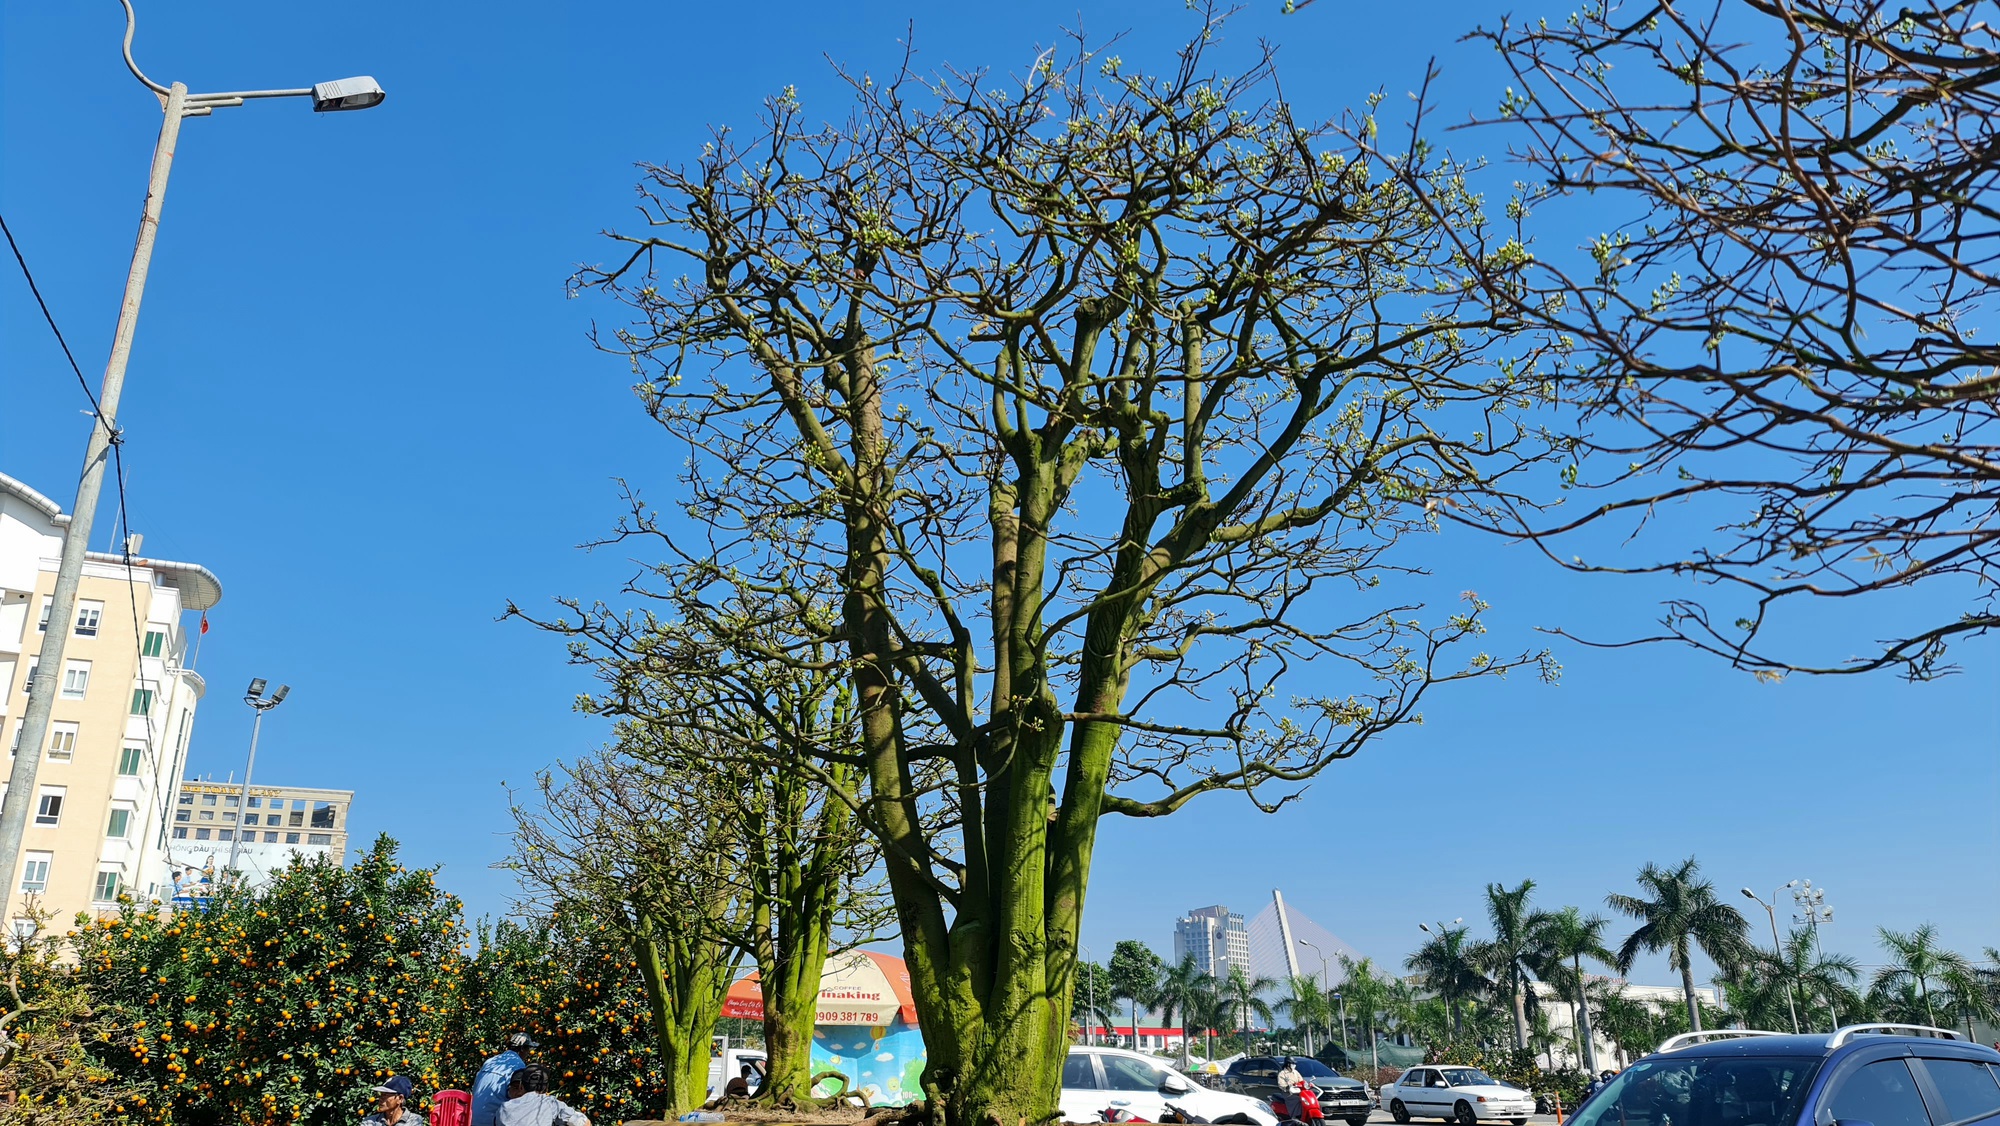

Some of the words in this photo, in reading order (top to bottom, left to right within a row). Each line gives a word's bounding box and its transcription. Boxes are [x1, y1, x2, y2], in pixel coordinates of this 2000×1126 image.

[169, 844, 192, 852] HÔNG
[821, 991, 881, 1001] inaking
[840, 1012, 857, 1021] 381
[861, 1012, 879, 1022] 789
